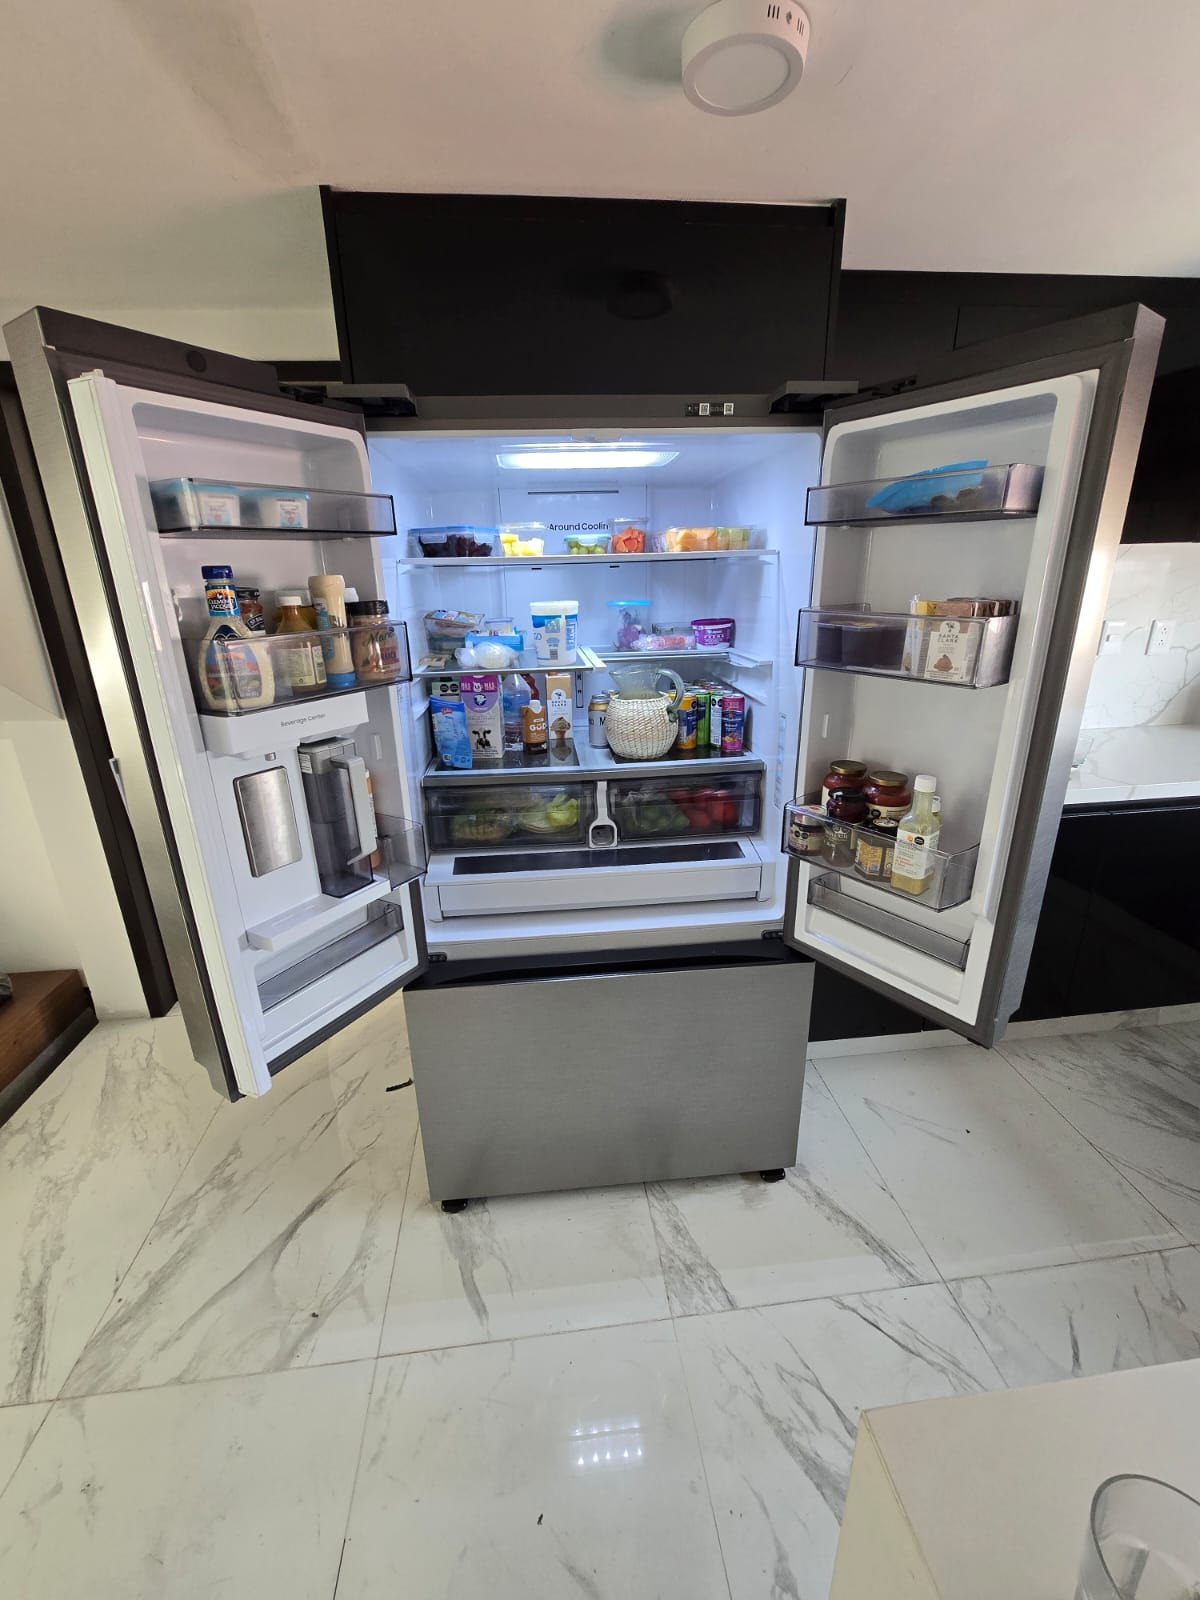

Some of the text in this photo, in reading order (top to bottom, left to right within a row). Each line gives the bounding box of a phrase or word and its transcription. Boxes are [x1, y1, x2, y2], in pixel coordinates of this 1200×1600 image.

[581, 522, 609, 531] Coolin
[280, 713, 325, 727] Beverage Center
